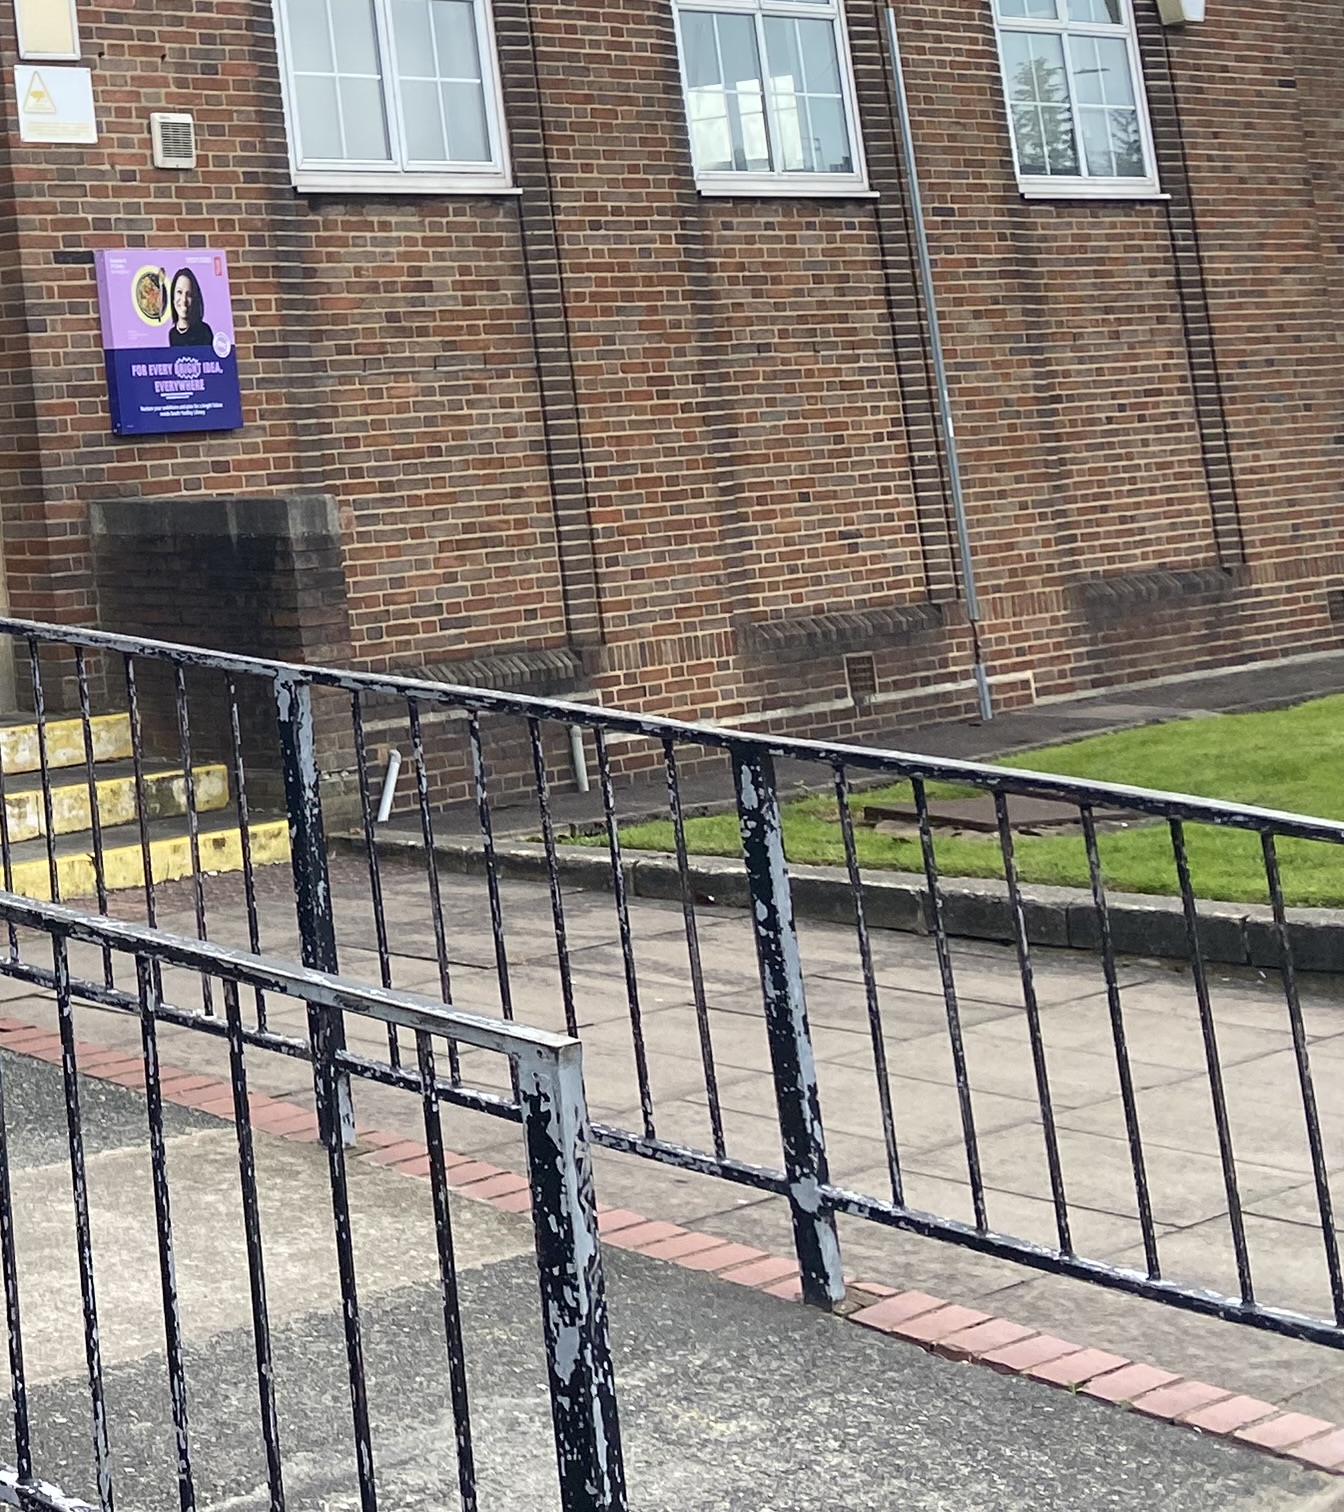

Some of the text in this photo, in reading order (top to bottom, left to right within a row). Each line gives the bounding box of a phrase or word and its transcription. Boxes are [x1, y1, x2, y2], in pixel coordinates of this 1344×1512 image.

[131, 364, 148, 377] FOR
[148, 363, 173, 376] EVERY
[154, 378, 206, 394] EVERYWHERE
